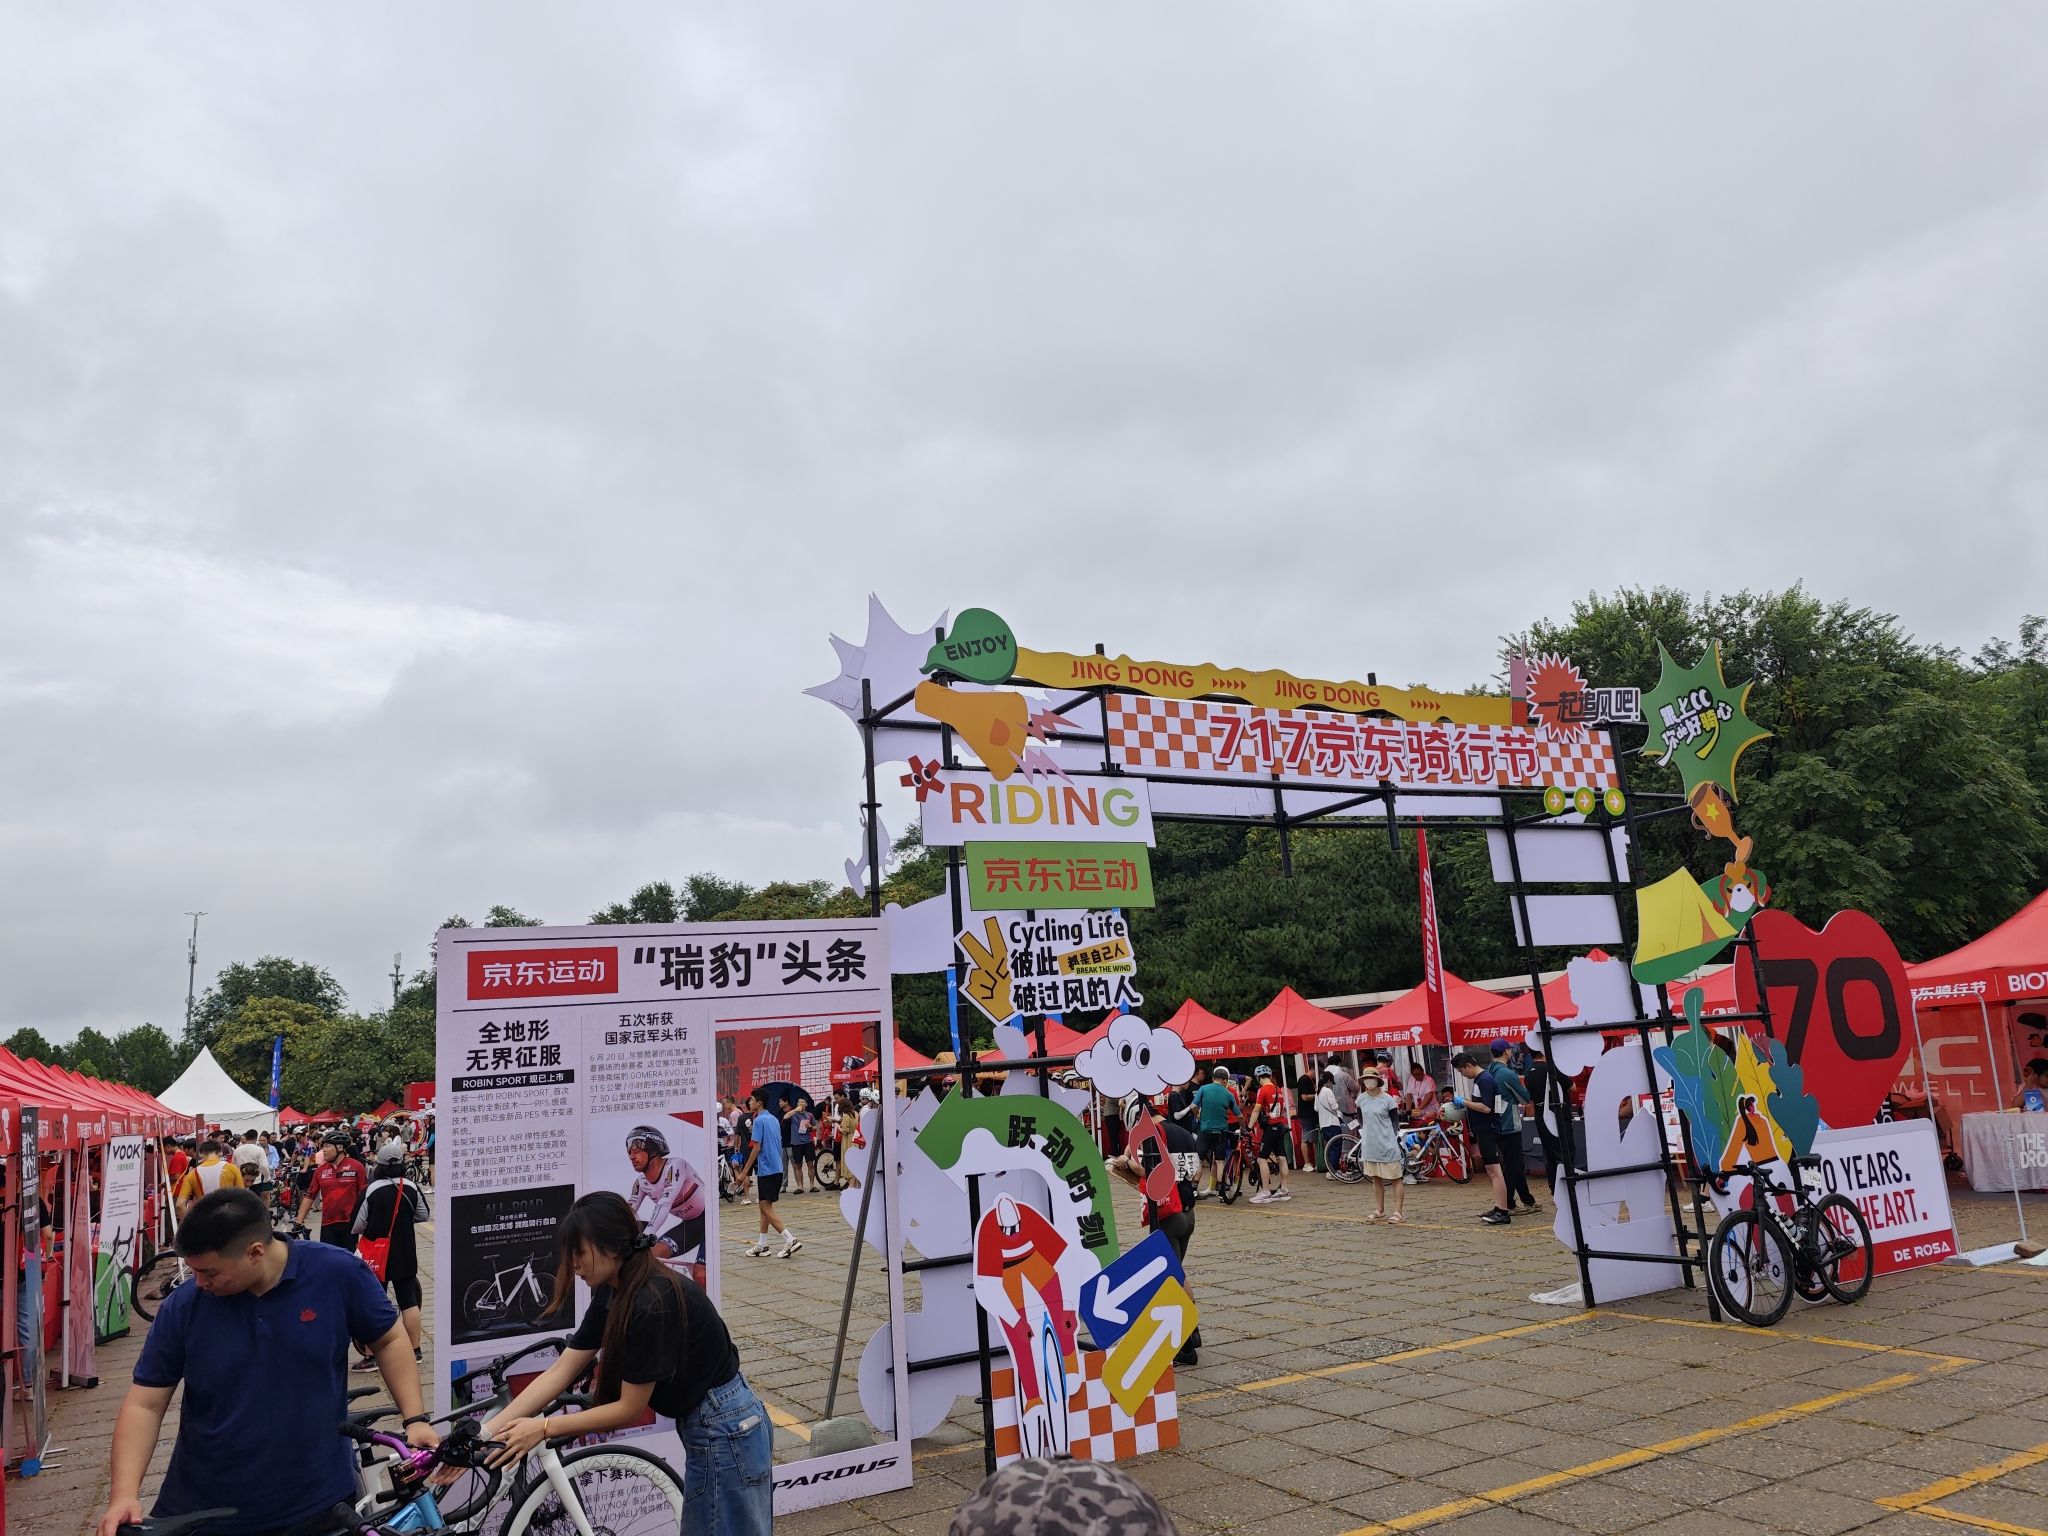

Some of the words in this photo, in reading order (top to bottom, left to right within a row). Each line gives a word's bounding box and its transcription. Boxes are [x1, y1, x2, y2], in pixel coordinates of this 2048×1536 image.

[944, 634, 1008, 662] ENJOY
[1071, 660, 1121, 682] JING
[1128, 665, 1194, 689] DONG
[1274, 679, 1317, 701] JING
[1323, 685, 1380, 708] DONG
[1210, 713, 1540, 782] 717京东骑行节
[950, 782, 1140, 828] RIDING
[983, 857, 1139, 893] 京东运动
[1010, 918, 1083, 949] Cycling
[1087, 914, 1125, 939] Life
[1010, 946, 1059, 979] 彼此
[1067, 942, 1125, 970] 都是自己人
[1076, 966, 1098, 975] BREAK
[1099, 964, 1112, 973] THE
[1113, 964, 1131, 972] WIND
[482, 959, 606, 988] 京东运动
[1013, 976, 1140, 1012] 破过风的人
[619, 1012, 674, 1028] 五次斩获
[1759, 957, 1901, 1063] 70
[479, 1018, 550, 1045] 全地形
[605, 1027, 688, 1046] 国家冠军头衔
[1318, 1033, 1368, 1047] 717京东骑行节
[1375, 1029, 1410, 1043] 京东运动
[1464, 1025, 1529, 1040] 717京东骑行节
[466, 1044, 562, 1072] 无界征服
[761, 1035, 781, 1065] 717
[462, 1078, 494, 1089] ROBIN
[496, 1075, 527, 1086] SPORT
[529, 1072, 564, 1084] 现已上市
[630, 1070, 662, 1080] GOMERA
[452, 1092, 494, 1104] 全新一代的
[495, 1091, 521, 1100] ROBIN
[524, 1111, 540, 1119] PES
[113, 1143, 142, 1160] VOOK
[487, 1135, 507, 1143] FLEX
[2017, 1132, 2046, 1152] THE
[516, 1154, 536, 1163] FLEX
[538, 1151, 566, 1161] SHOCK
[1840, 1150, 1911, 1191] YEARS.
[1008, 1115, 1109, 1250] 跃动时刻
[1825, 1205, 1855, 1238] NE
[1857, 1189, 1928, 1231] HEART.
[1893, 1249, 1912, 1263] DE
[1914, 1241, 1952, 1257] ROSA
[772, 1456, 899, 1492] PARDUS
